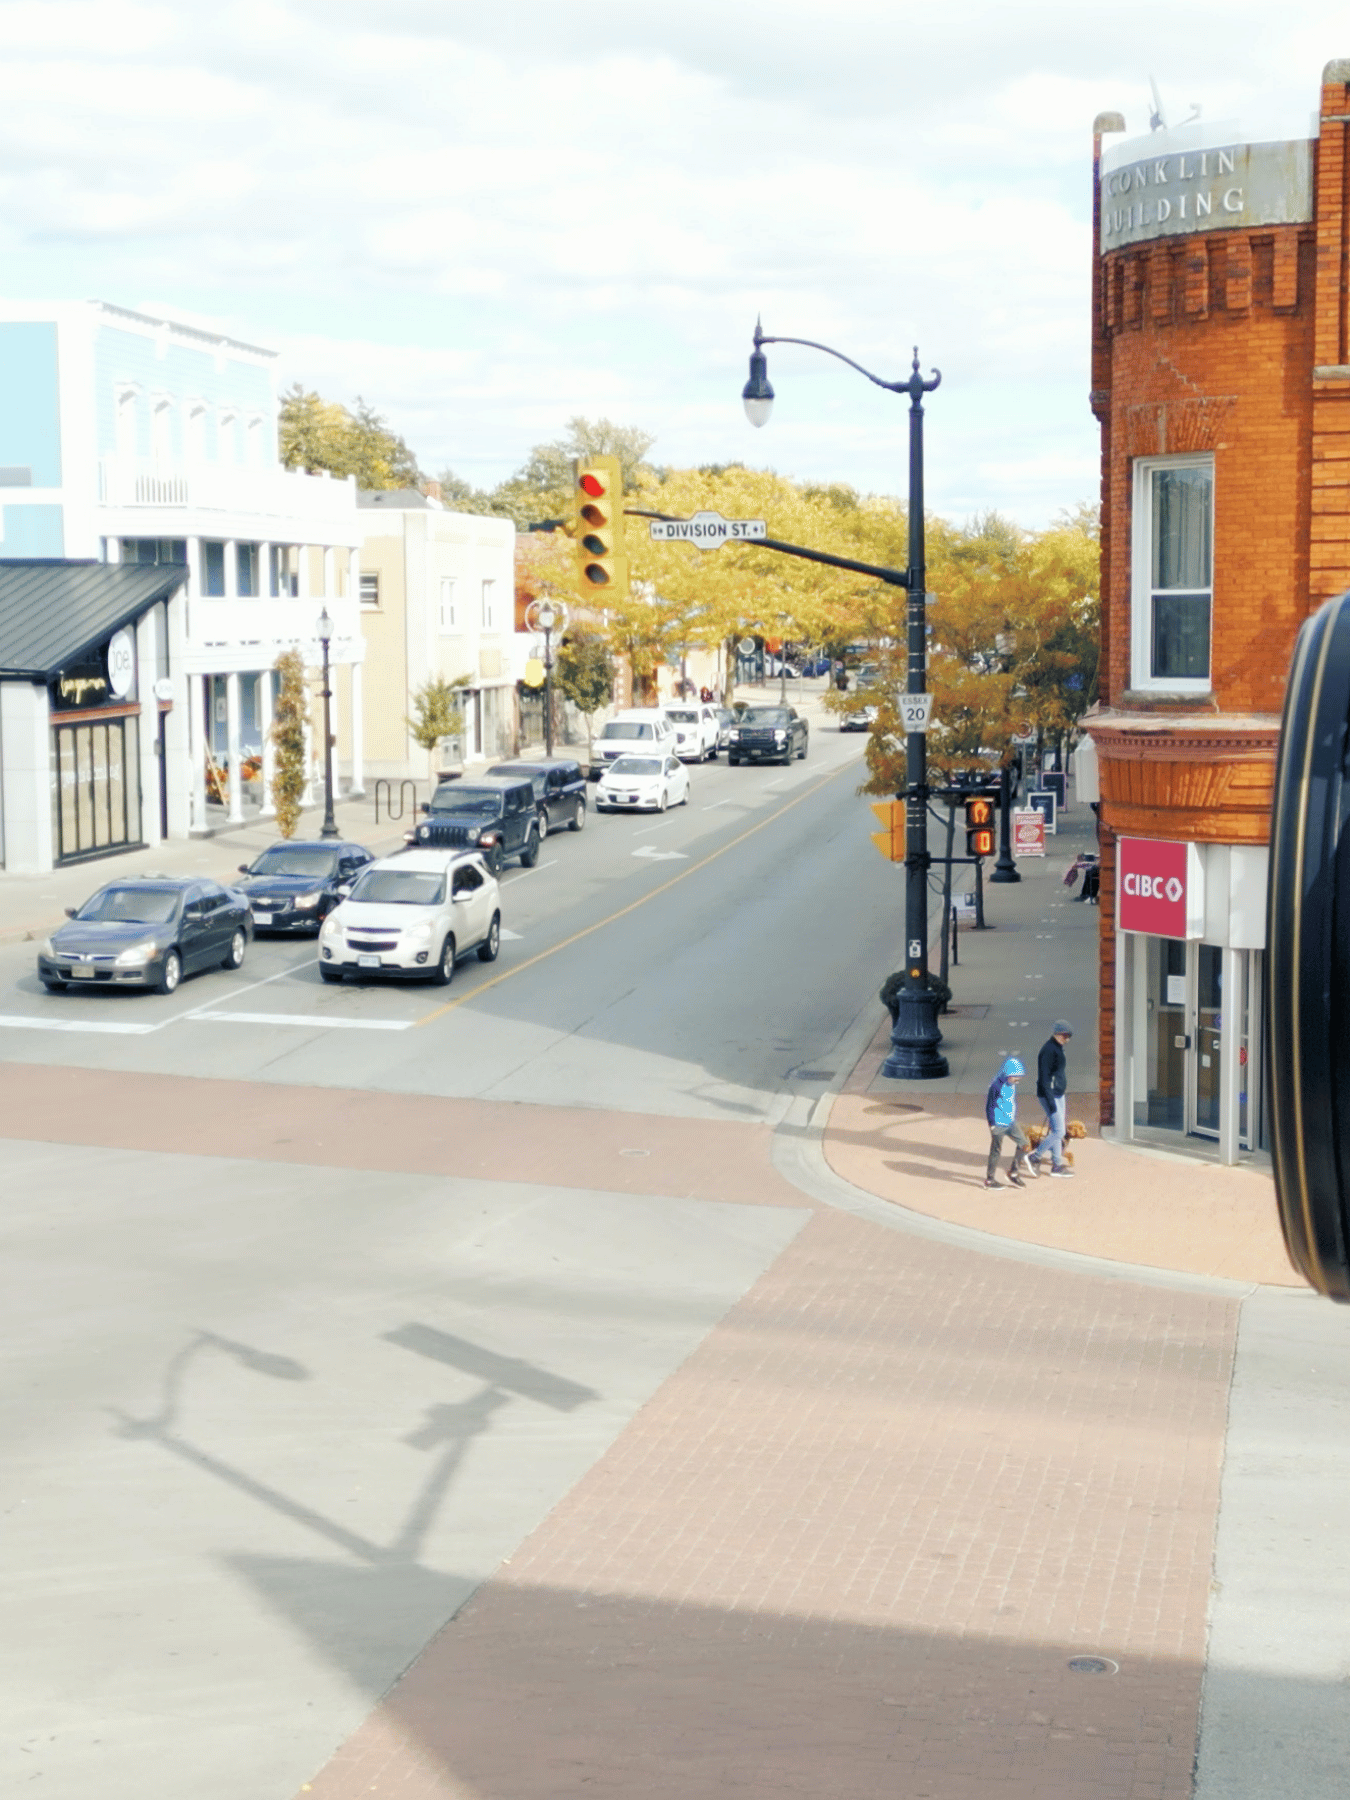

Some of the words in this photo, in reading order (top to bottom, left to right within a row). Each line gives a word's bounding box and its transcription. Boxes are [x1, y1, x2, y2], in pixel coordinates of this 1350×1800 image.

[1108, 148, 1236, 198] CONKLIN
[1106, 187, 1244, 236] BUILDING
[666, 523, 727, 538] DIVISION
[731, 522, 752, 537] ST.
[902, 696, 928, 705] ESSEX
[906, 707, 925, 721] 20
[1124, 873, 1164, 899] CIBC
